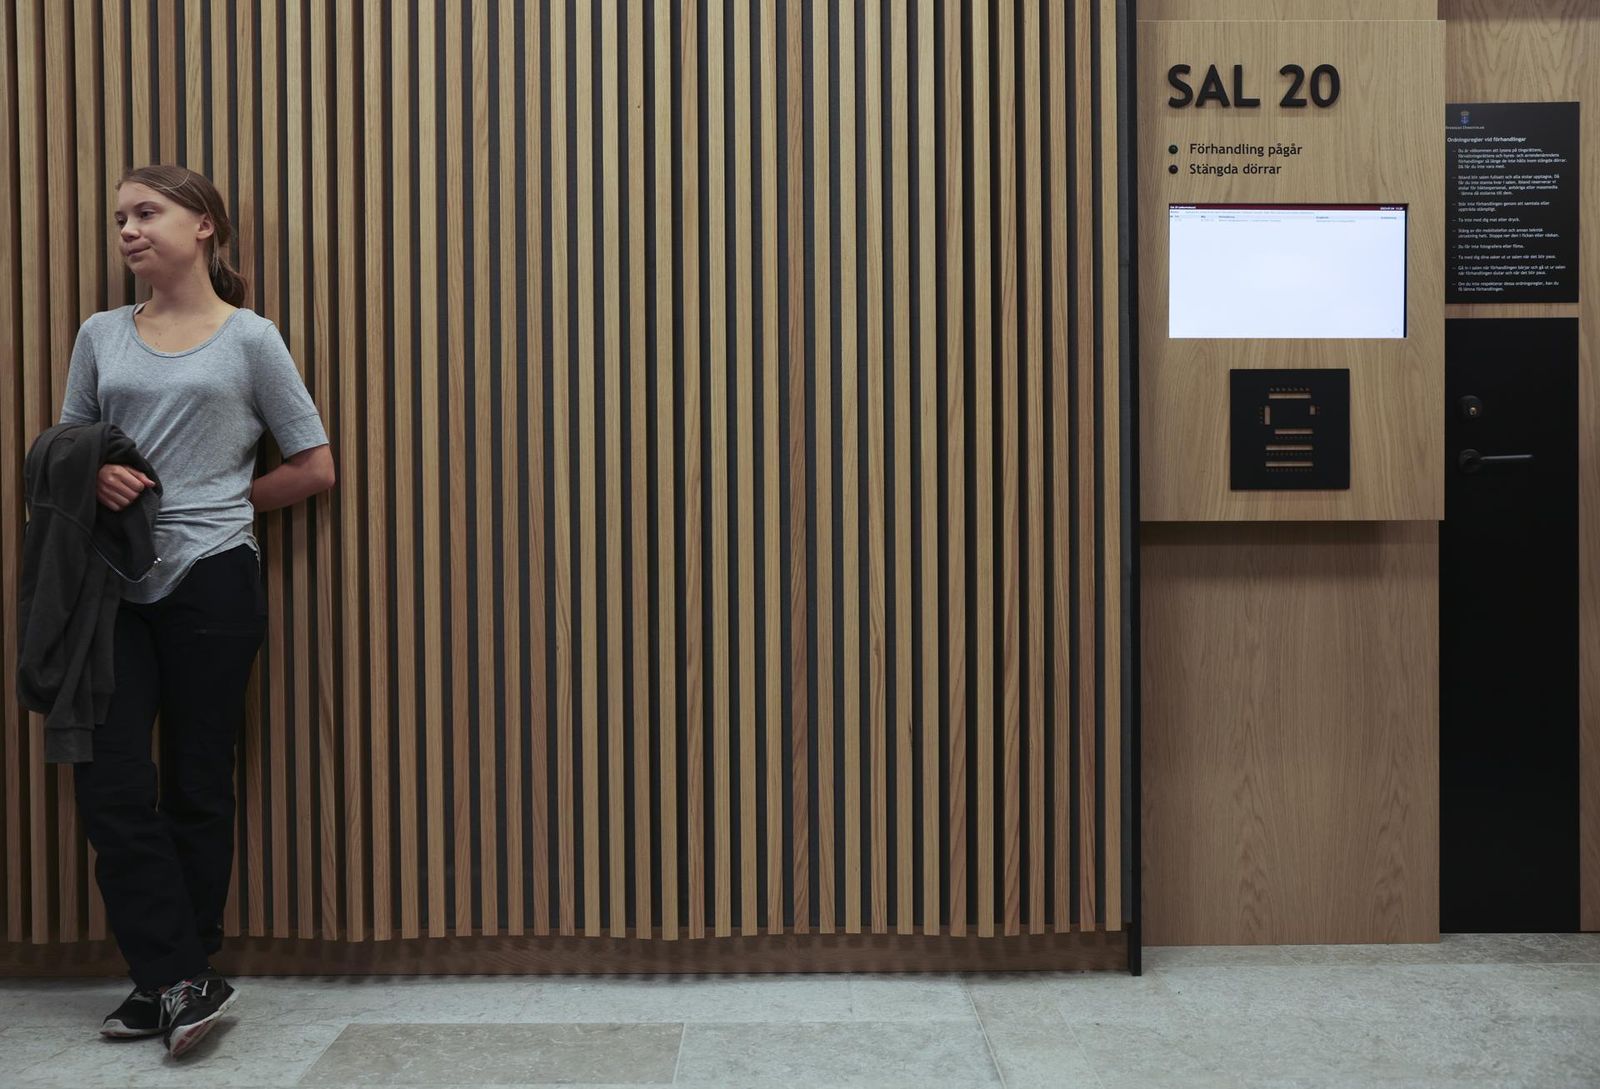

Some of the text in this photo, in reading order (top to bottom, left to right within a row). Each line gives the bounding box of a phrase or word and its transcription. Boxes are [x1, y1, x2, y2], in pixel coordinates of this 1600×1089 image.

[1168, 64, 1340, 109] SAL 20
[1190, 143, 1303, 157] Förhandling pågår
[1190, 163, 1282, 177] Stängda dörrar
